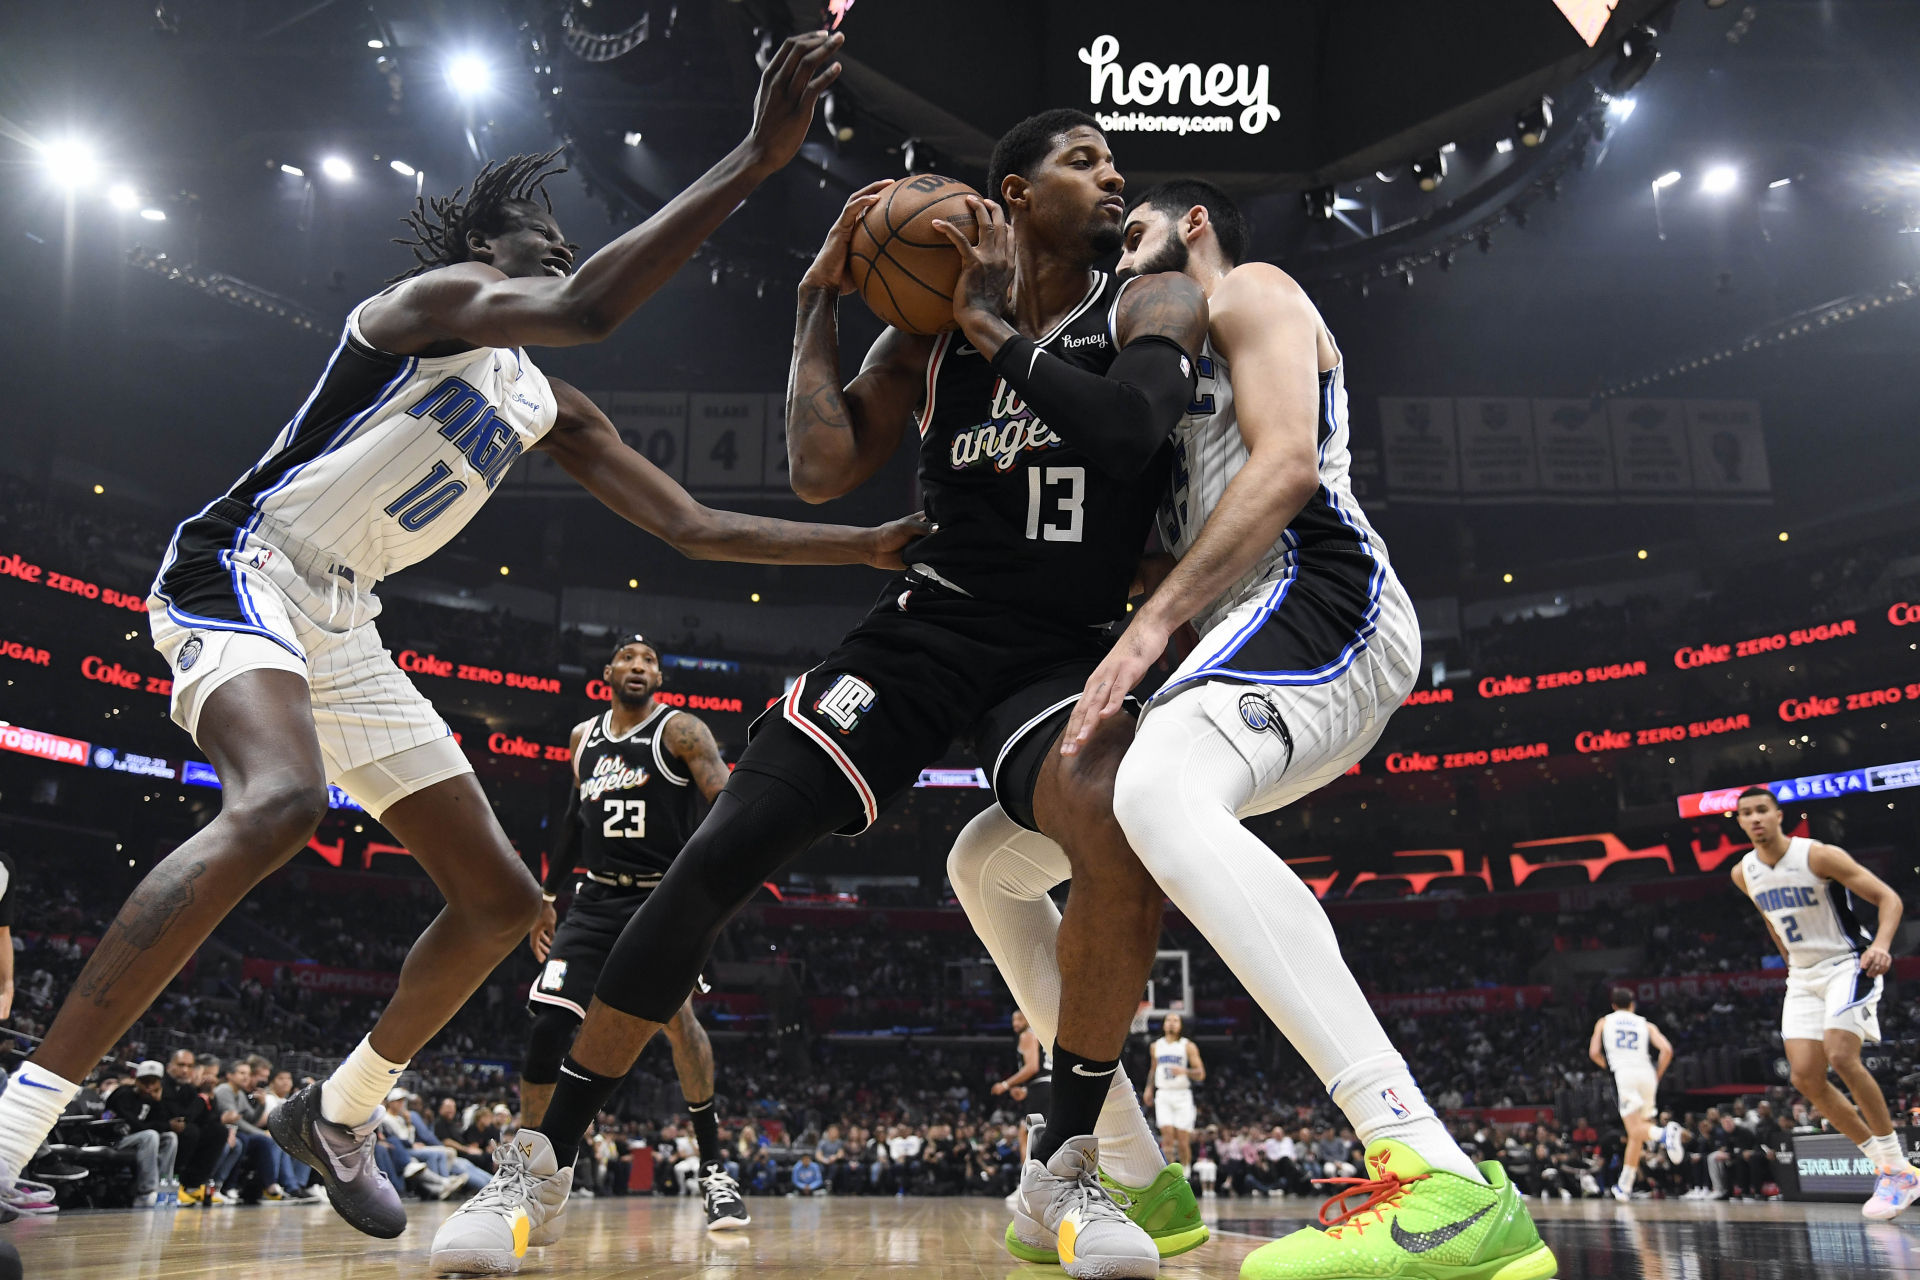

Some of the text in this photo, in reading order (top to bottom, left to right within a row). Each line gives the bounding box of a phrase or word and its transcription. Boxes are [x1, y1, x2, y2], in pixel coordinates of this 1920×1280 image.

[1078, 35, 1281, 134] honey
[1061, 332, 1108, 348] honey
[710, 429, 739, 471] 4
[384, 459, 467, 532] 10
[1026, 467, 1085, 542] 13
[0, 554, 42, 583] oke
[46, 571, 99, 599] ZERO
[1888, 602, 1920, 626] Co
[0, 639, 51, 667] UGAR
[1674, 619, 1857, 669] Coke ZERO SUGAR
[81, 655, 173, 696] Coke ZE
[398, 650, 561, 694] Coke ZERO SUGAR
[1478, 660, 1647, 698] Coke ZERO SUGAR
[585, 679, 612, 701] Co
[688, 696, 742, 713] SUGAR
[1778, 695, 1841, 722] Coke
[1846, 687, 1902, 710] ZERO
[0, 727, 83, 762] TOSHIBA
[488, 732, 571, 761] Coke ZER
[1575, 714, 1750, 753] Coke ZERO SUGAR
[593, 756, 625, 777] los
[1385, 751, 1439, 773] Coke
[1443, 750, 1488, 768] ZERO
[1490, 742, 1549, 763] SUGAR
[580, 766, 648, 801] ngeles
[1795, 775, 1862, 796] DELTA
[603, 800, 646, 838] 23
[1755, 886, 1819, 912] MAGIC
[1781, 915, 1803, 942] 2
[1616, 1030, 1638, 1050] 22
[1797, 1158, 1850, 1176] STARLUX
